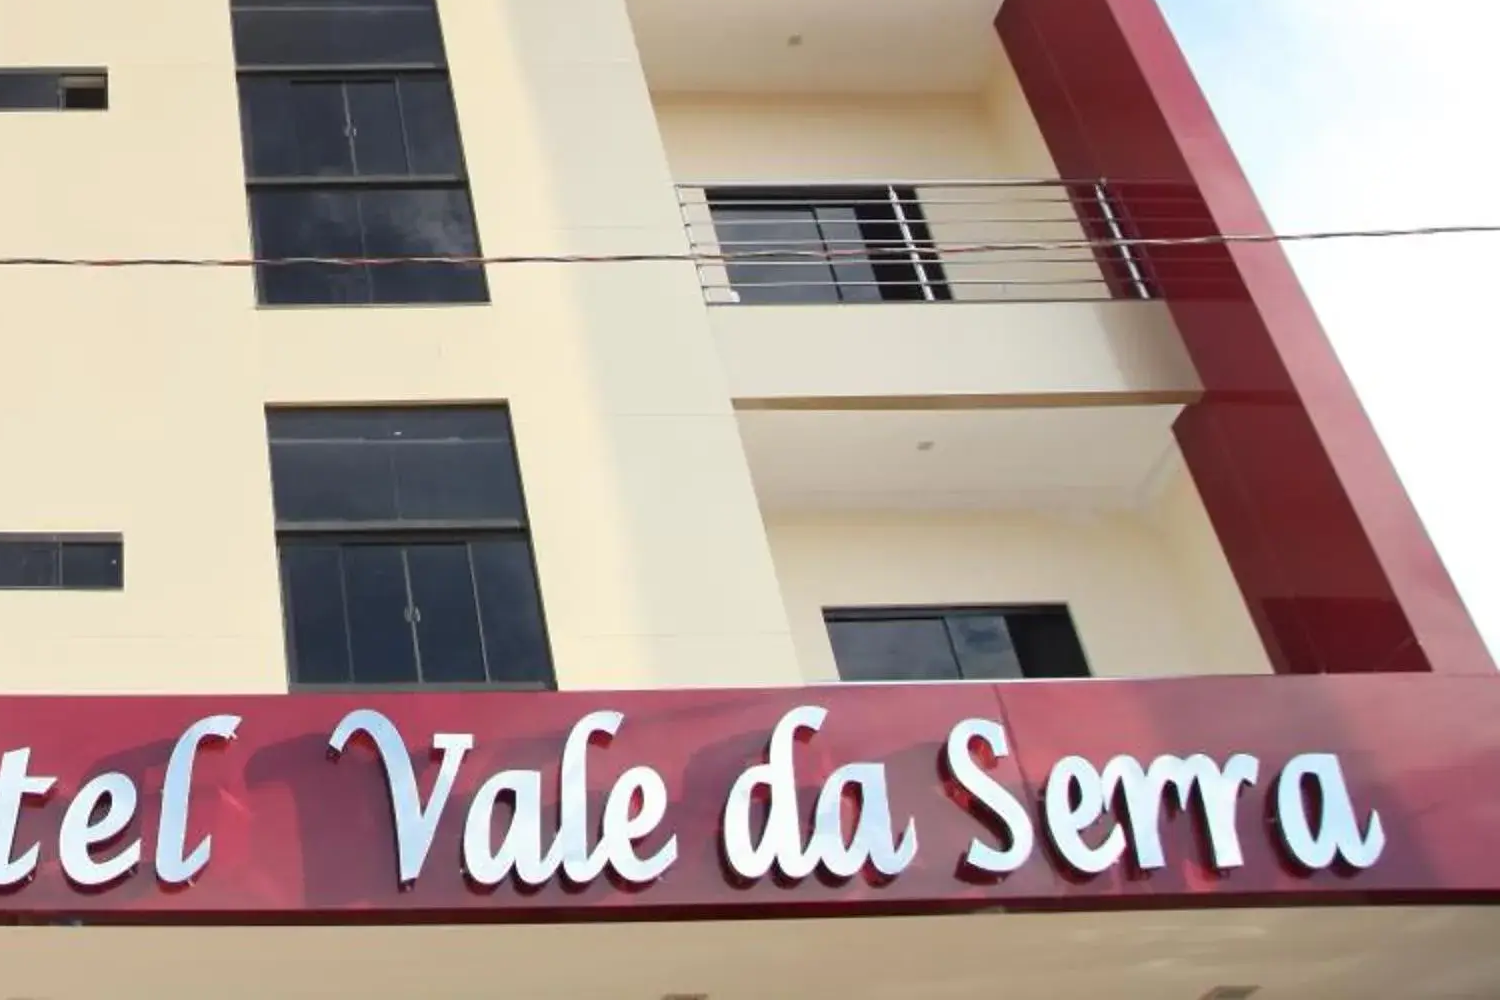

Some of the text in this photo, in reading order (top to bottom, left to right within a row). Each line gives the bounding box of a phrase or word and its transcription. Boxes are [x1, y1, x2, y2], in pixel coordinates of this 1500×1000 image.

[328, 708, 678, 888] Vale
[723, 705, 917, 880] da
[946, 717, 1386, 875] Serra
